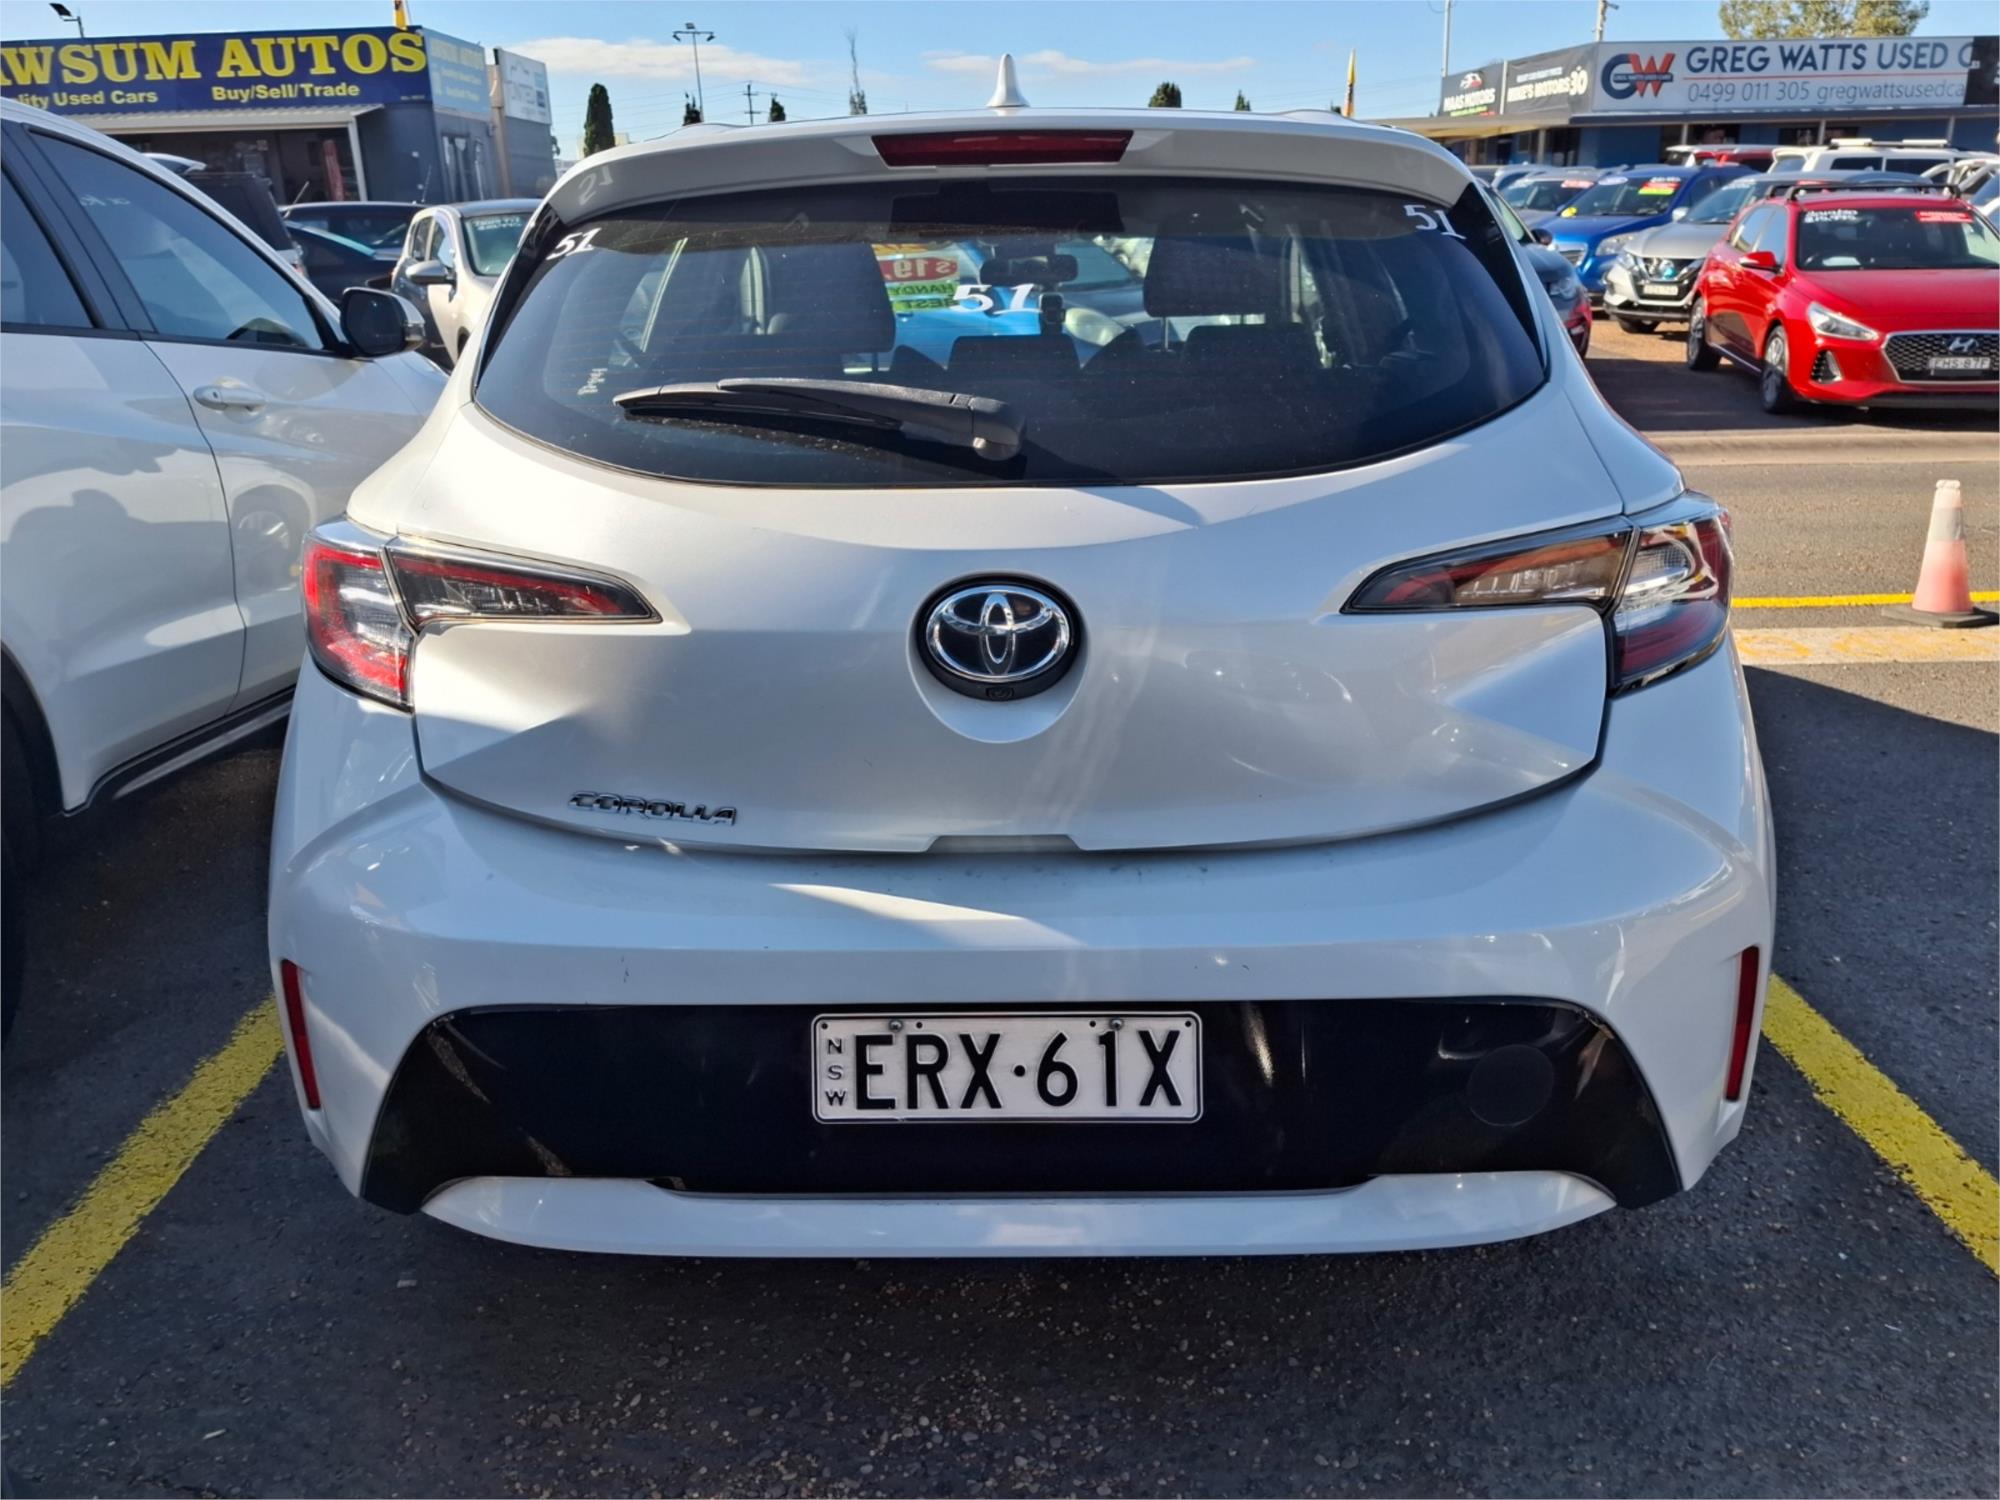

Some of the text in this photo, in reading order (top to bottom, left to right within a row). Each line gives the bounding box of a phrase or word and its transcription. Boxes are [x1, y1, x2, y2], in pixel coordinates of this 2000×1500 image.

[216, 32, 427, 77] AUTOS
[1686, 46, 1770, 73] GREG
[1779, 43, 1867, 71] WATTS
[1877, 42, 1949, 70] USED
[1601, 52, 1676, 100] GW
[1688, 83, 1736, 102] 0499
[1742, 82, 1770, 100] 011
[1776, 81, 1811, 101] 305
[53, 91, 105, 106] Used
[110, 90, 158, 104] Cars
[1403, 204, 1467, 240] 51
[546, 227, 601, 260] 51
[949, 283, 1043, 315] 51
[568, 791, 738, 826] COROLLA
